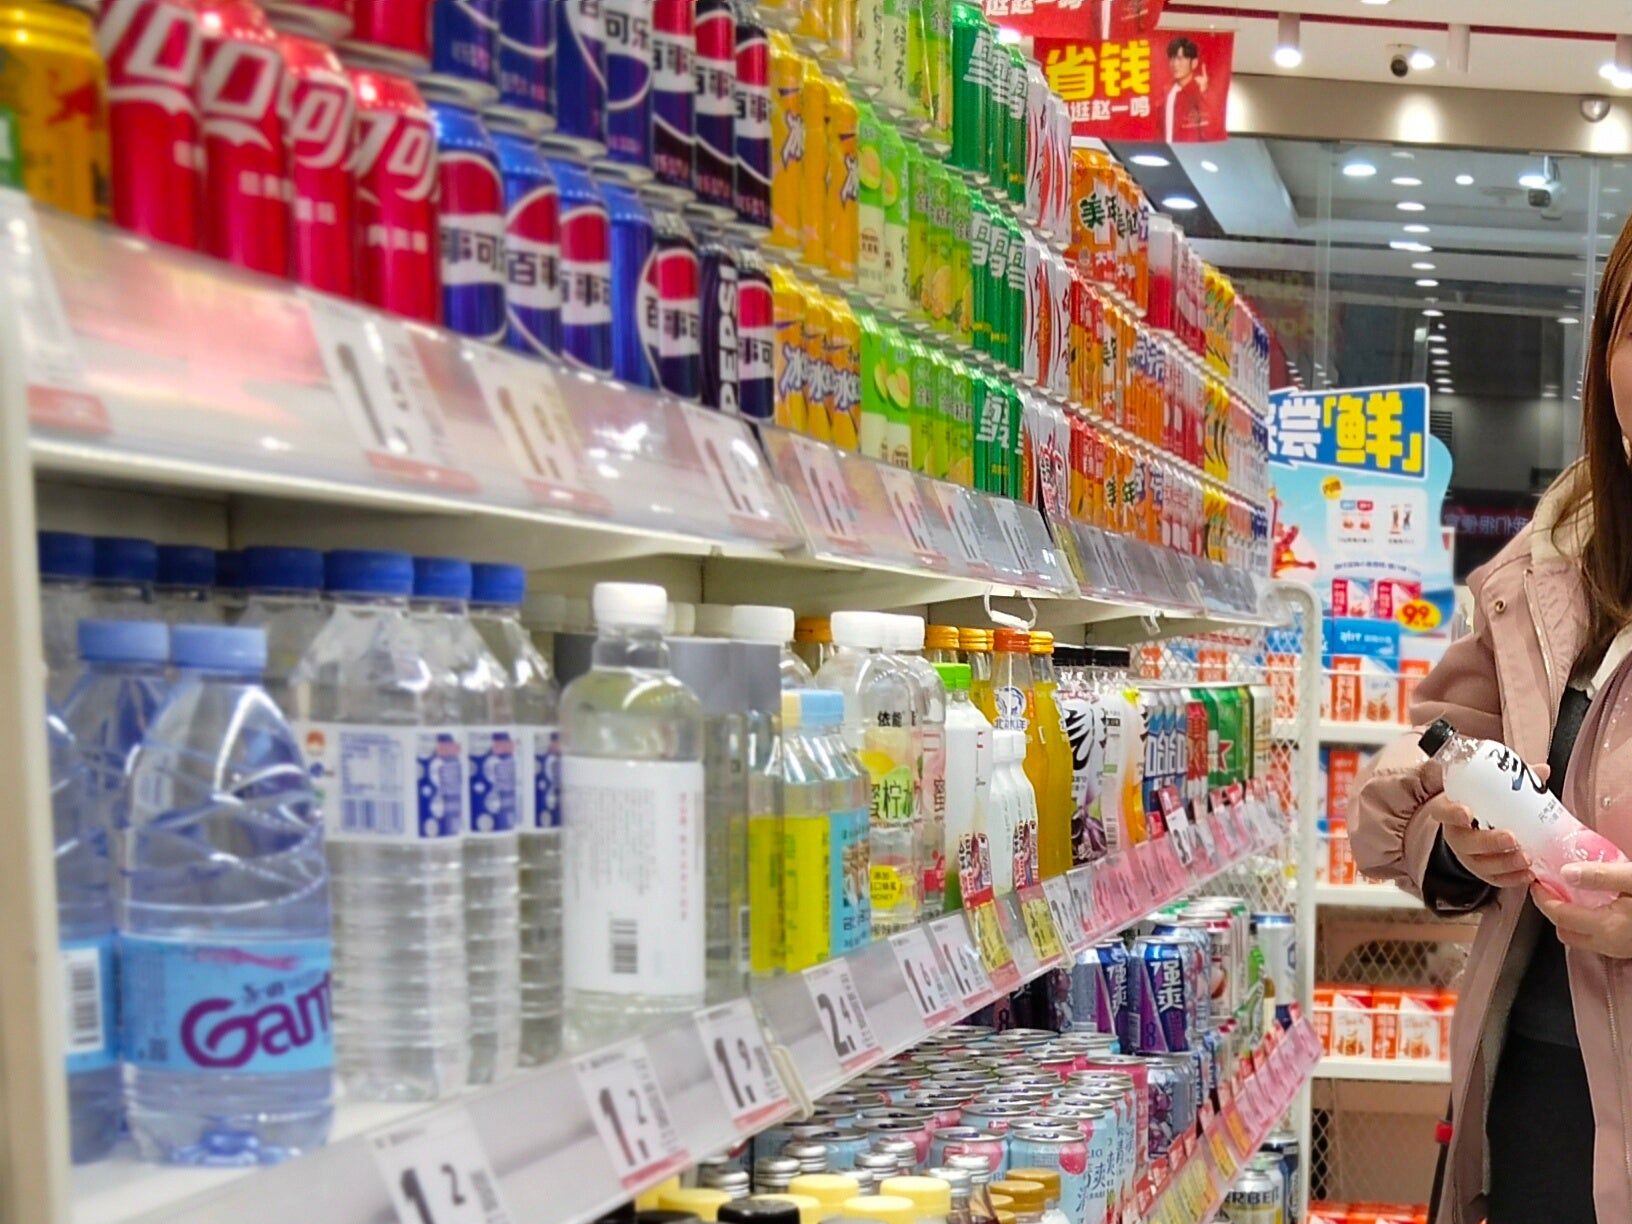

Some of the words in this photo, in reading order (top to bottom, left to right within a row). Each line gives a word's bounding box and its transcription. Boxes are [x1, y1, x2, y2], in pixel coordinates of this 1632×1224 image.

[1045, 40, 1150, 101] 省钱
[1069, 97, 1150, 122] 逛赵一鸣
[1158, 962, 1185, 1013] 强爽
